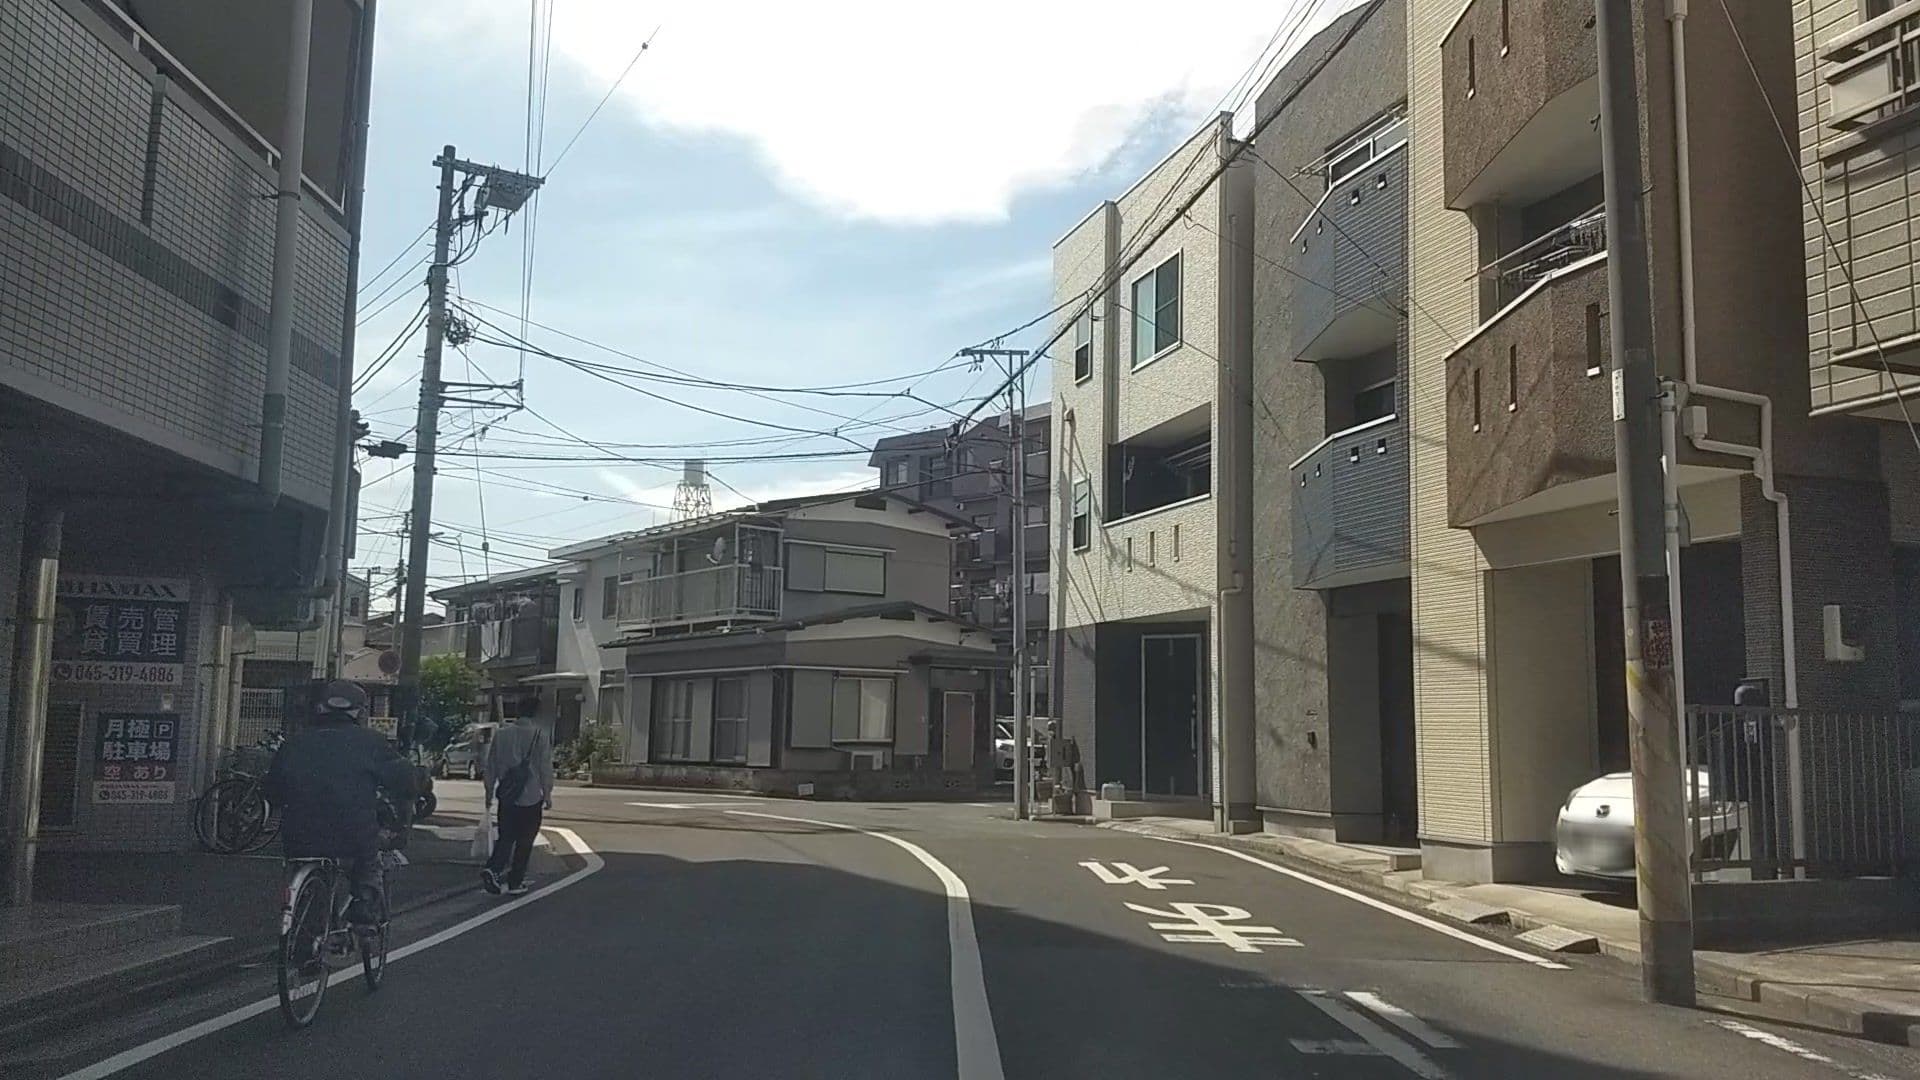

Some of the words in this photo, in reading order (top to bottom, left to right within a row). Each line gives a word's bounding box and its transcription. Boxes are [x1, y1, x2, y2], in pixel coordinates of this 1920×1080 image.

[117, 607, 145, 656] 売買
[150, 607, 179, 656] 管理
[103, 741, 171, 760] 駐車場
